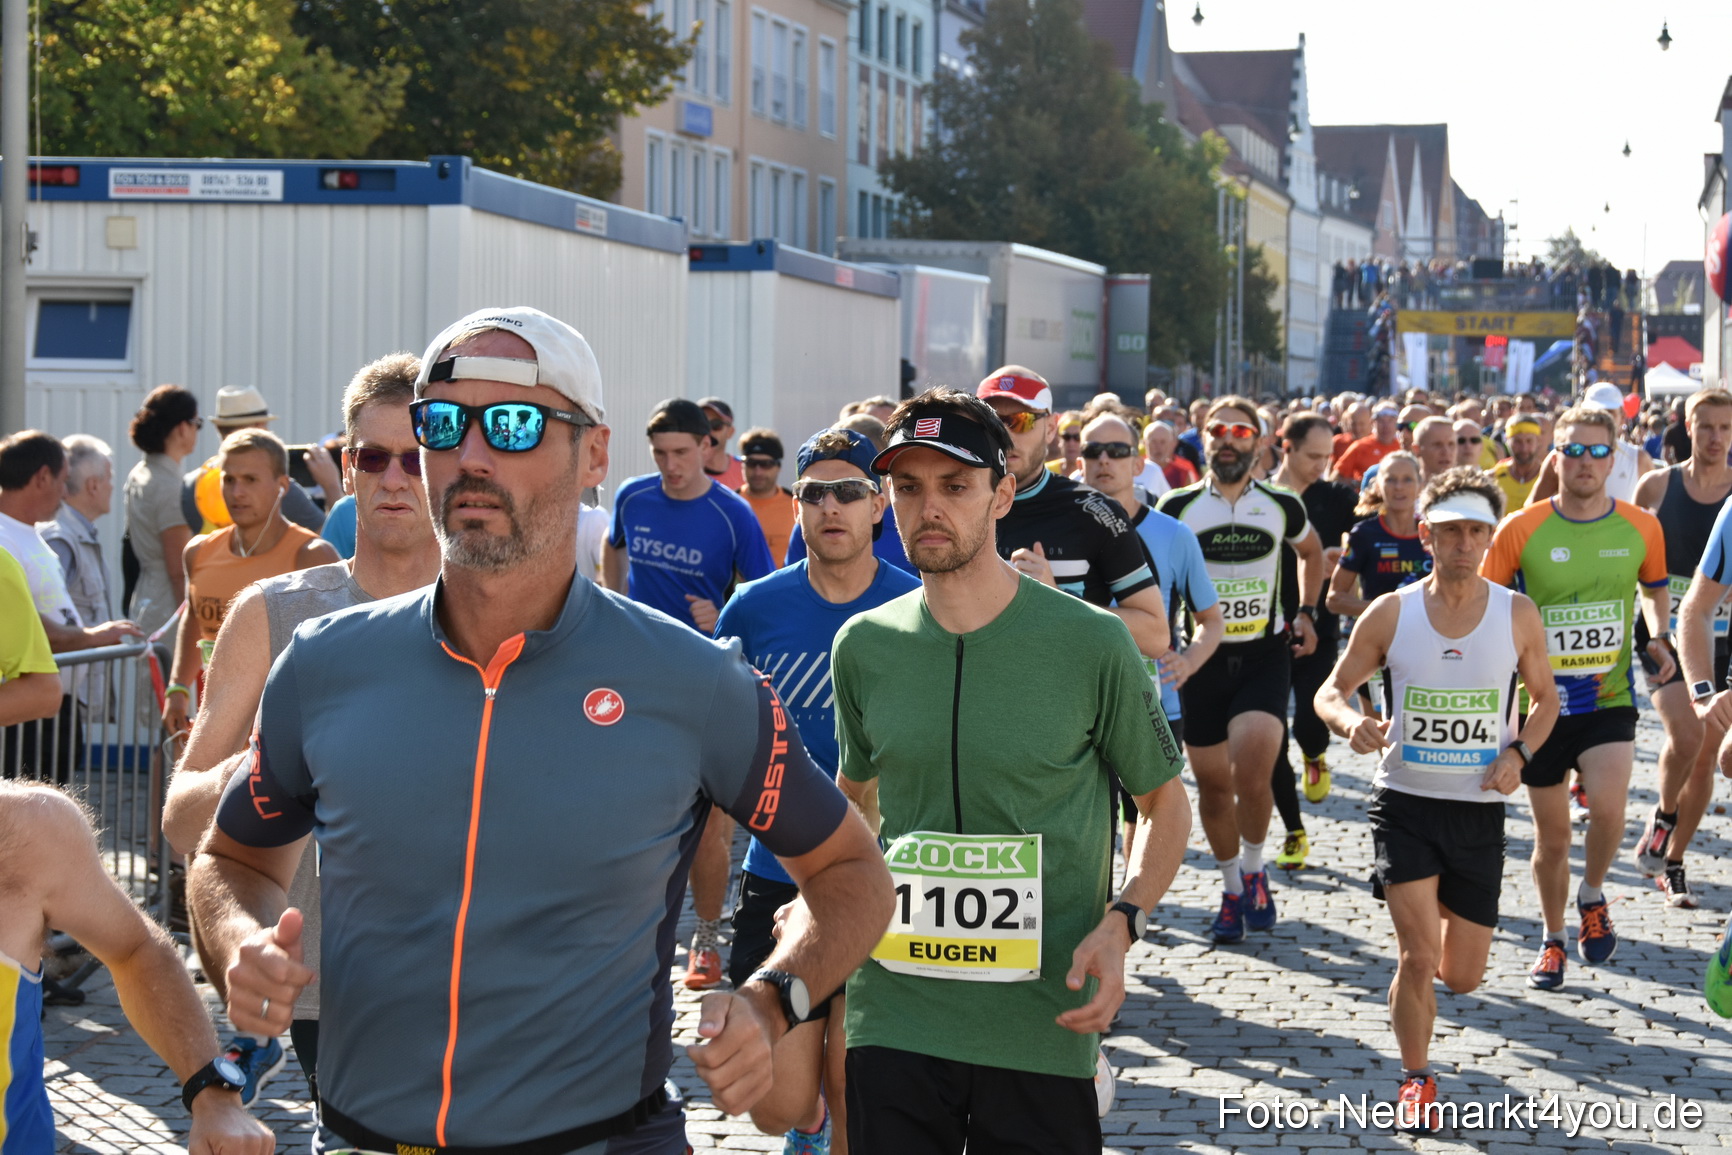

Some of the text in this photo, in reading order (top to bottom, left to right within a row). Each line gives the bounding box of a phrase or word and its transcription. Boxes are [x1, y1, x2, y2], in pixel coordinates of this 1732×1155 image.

[464, 317, 523, 328] WNING
[1455, 316, 1516, 330] START
[1211, 533, 1261, 544] RADAU
[631, 536, 703, 565] SYSCAD
[1377, 560, 1432, 573] MENSC
[1219, 598, 1261, 619] 286
[1548, 604, 1617, 625] BOCK
[1225, 623, 1256, 634] LAND
[1554, 627, 1616, 651] 1282
[1561, 655, 1612, 668] RASMUS
[1409, 689, 1491, 712] BOCK
[1149, 705, 1180, 767] TERREX
[1412, 717, 1488, 744] 2504
[1417, 750, 1482, 764] THOMAS
[889, 839, 1025, 874] BOCK
[896, 884, 1034, 930] 1102 A
[909, 941, 997, 962] EUGEN
